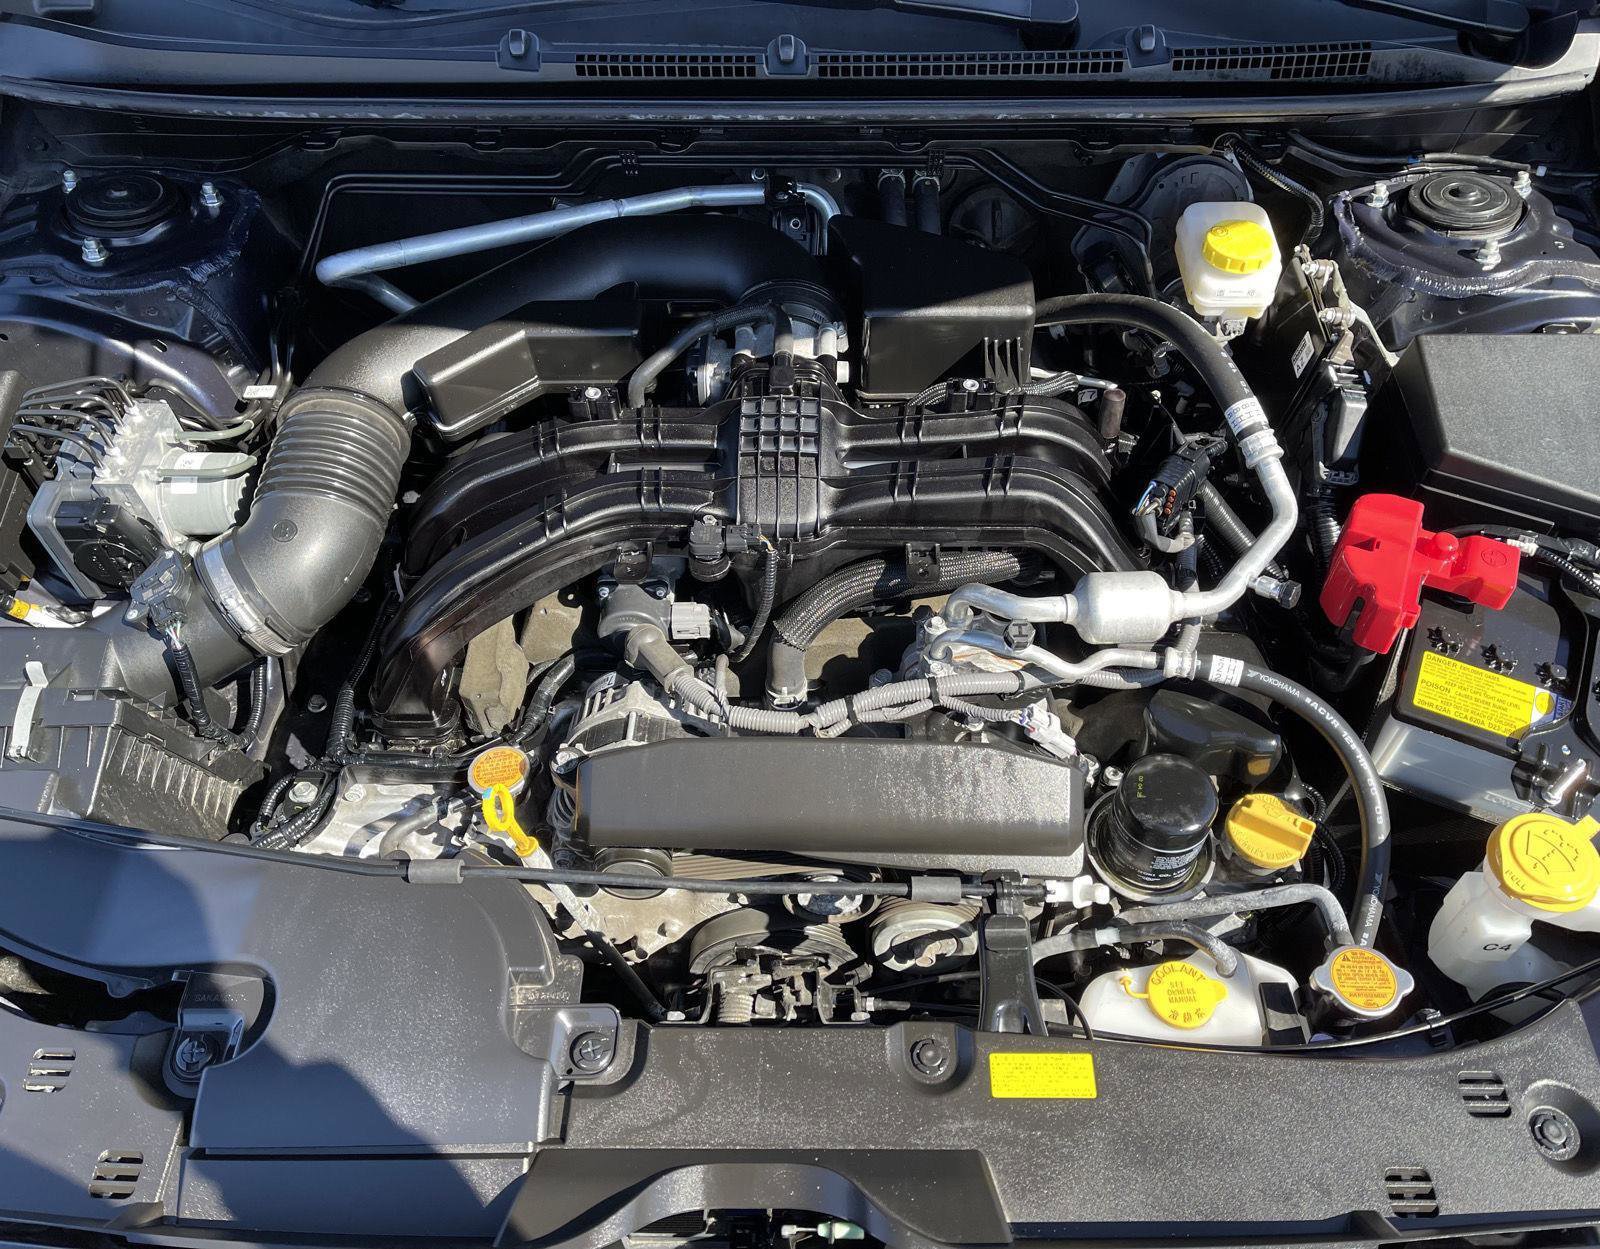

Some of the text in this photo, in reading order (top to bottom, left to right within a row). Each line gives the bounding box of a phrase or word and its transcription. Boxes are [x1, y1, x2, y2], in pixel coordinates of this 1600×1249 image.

[1426, 654, 1458, 669] DANGER
[1259, 672, 1301, 698] YOKOHAMA
[1420, 679, 1451, 694] POISON
[1454, 710, 1469, 722] CCA
[1364, 882, 1381, 927] YOKOHAMA
[1482, 943, 1512, 951] C4
[1151, 963, 1206, 985] COOLANT
[1168, 995, 1197, 1004] MANUAL
